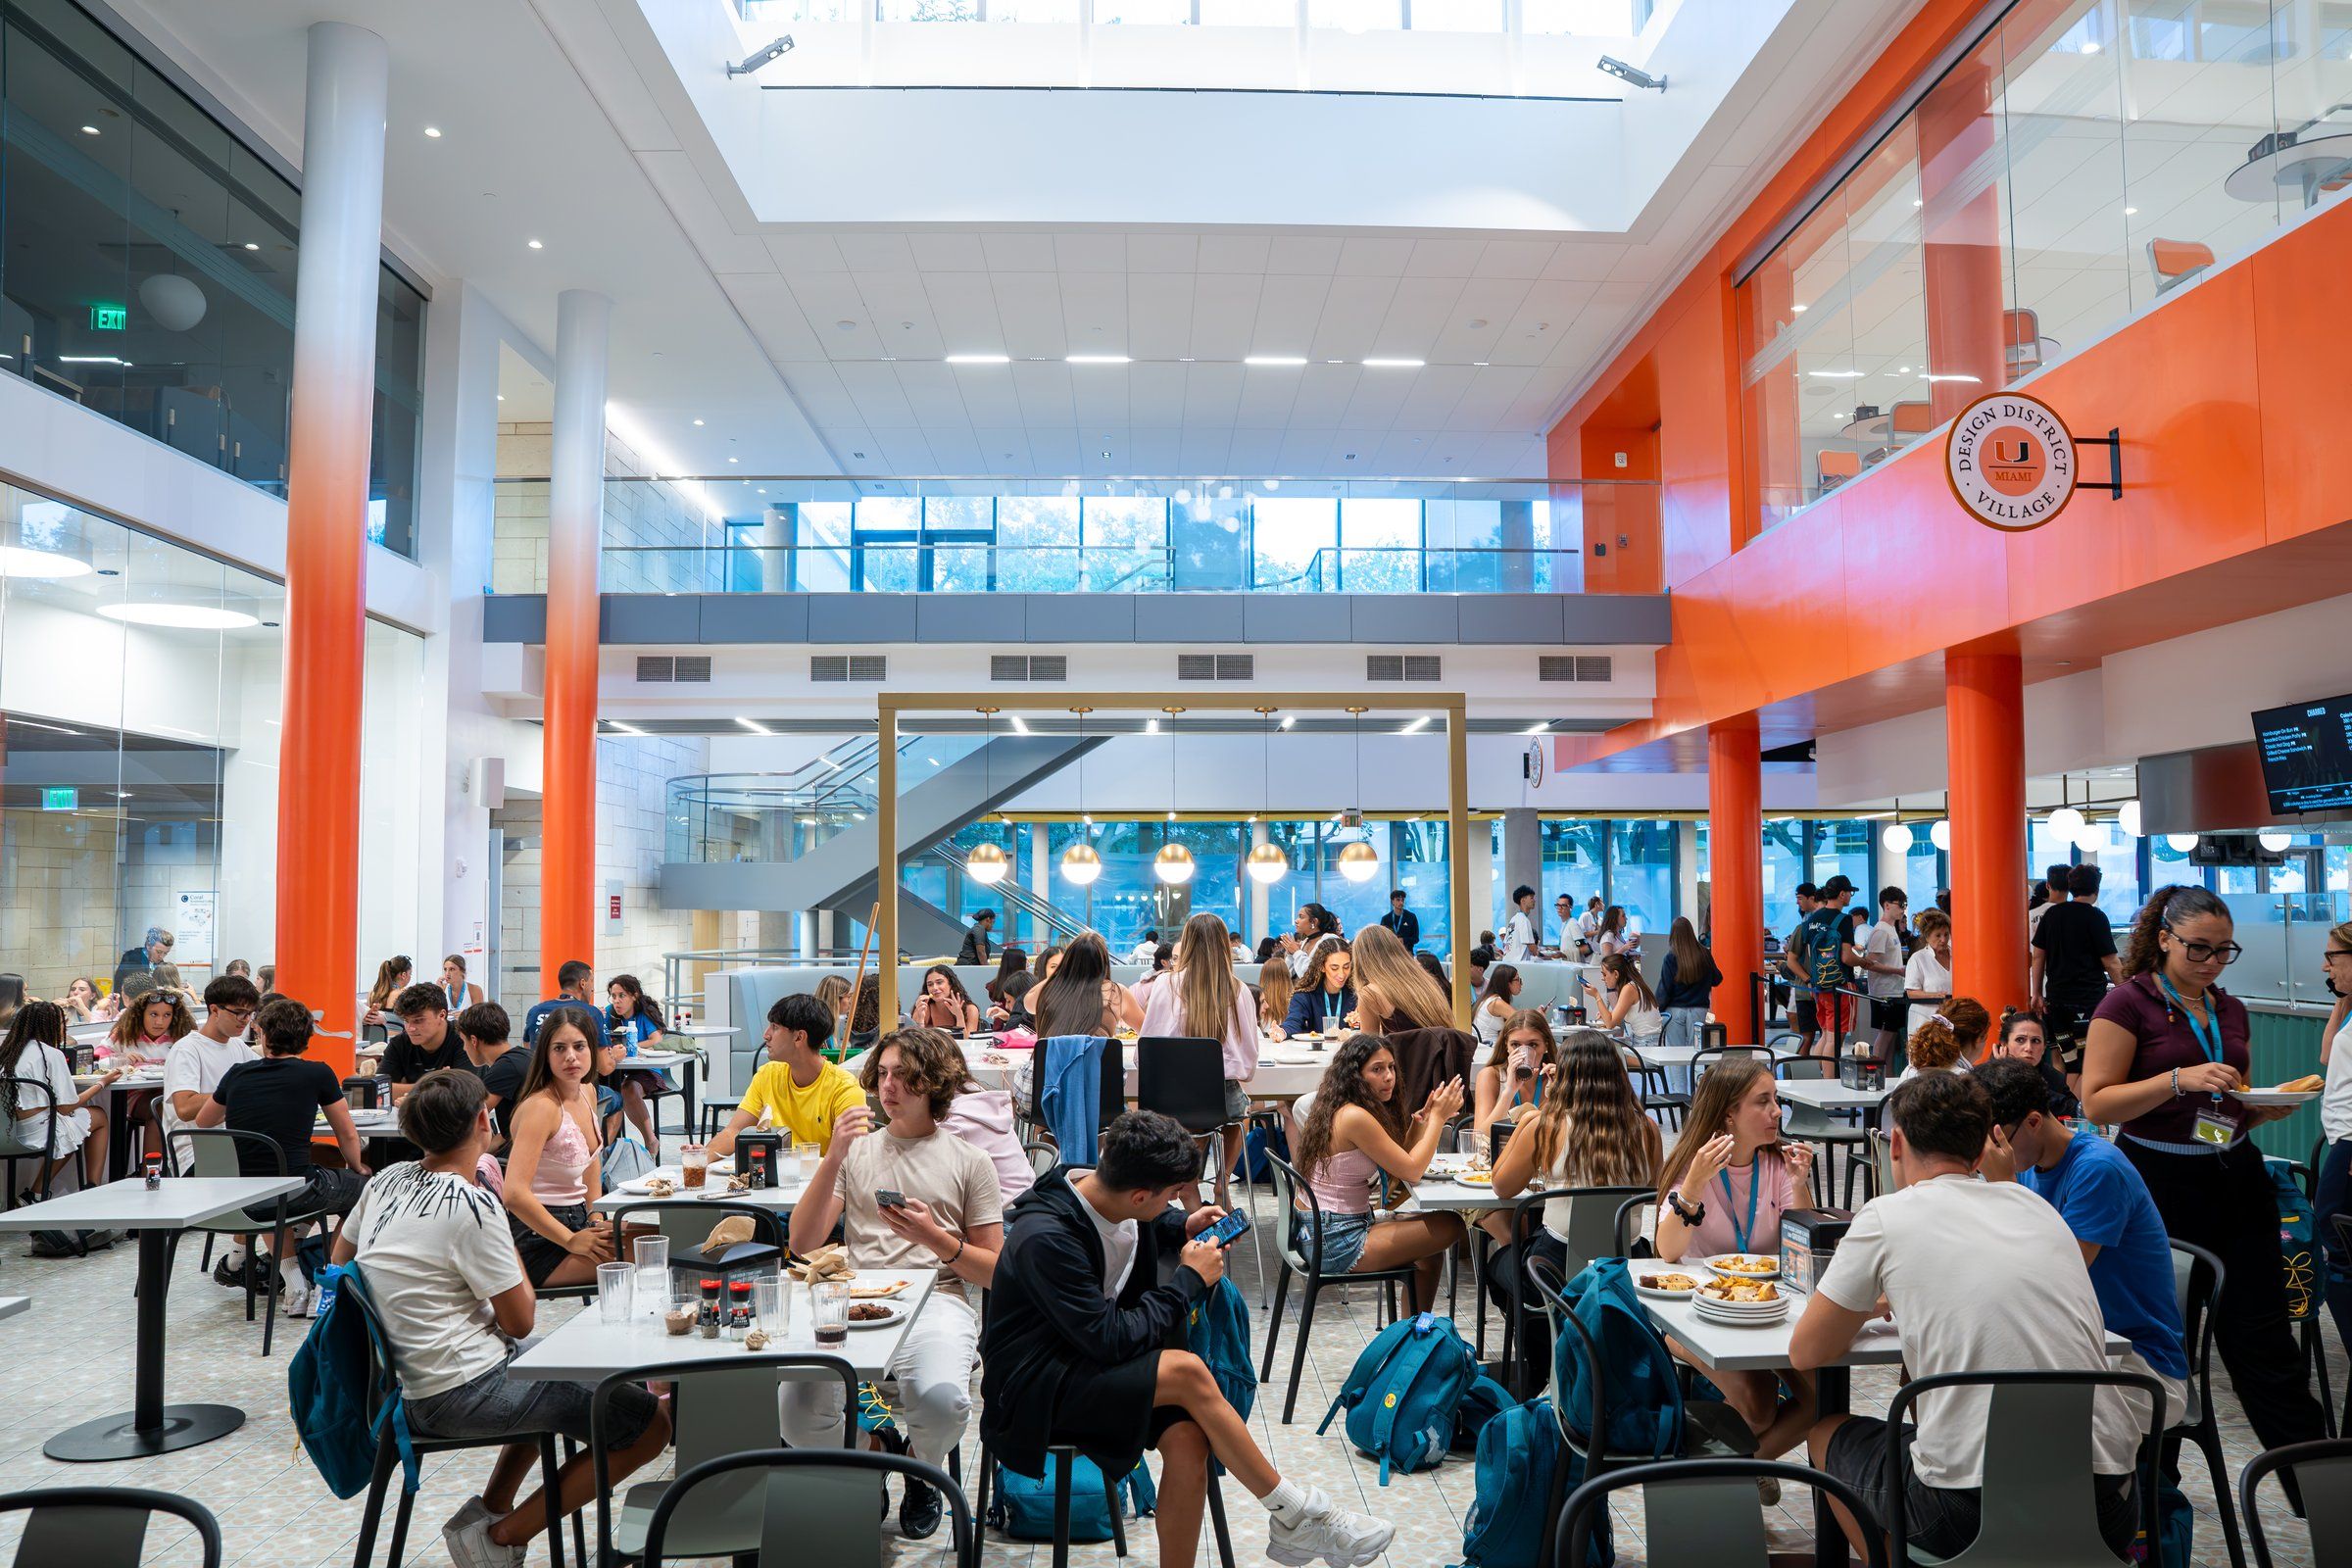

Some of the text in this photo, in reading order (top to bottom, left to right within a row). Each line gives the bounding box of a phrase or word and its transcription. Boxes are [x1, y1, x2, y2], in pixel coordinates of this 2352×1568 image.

[1959, 404, 2067, 475] DESIGN DISTRICT
[1995, 471, 2032, 481] MIAMI
[1976, 490, 2055, 518] VILLAGE
